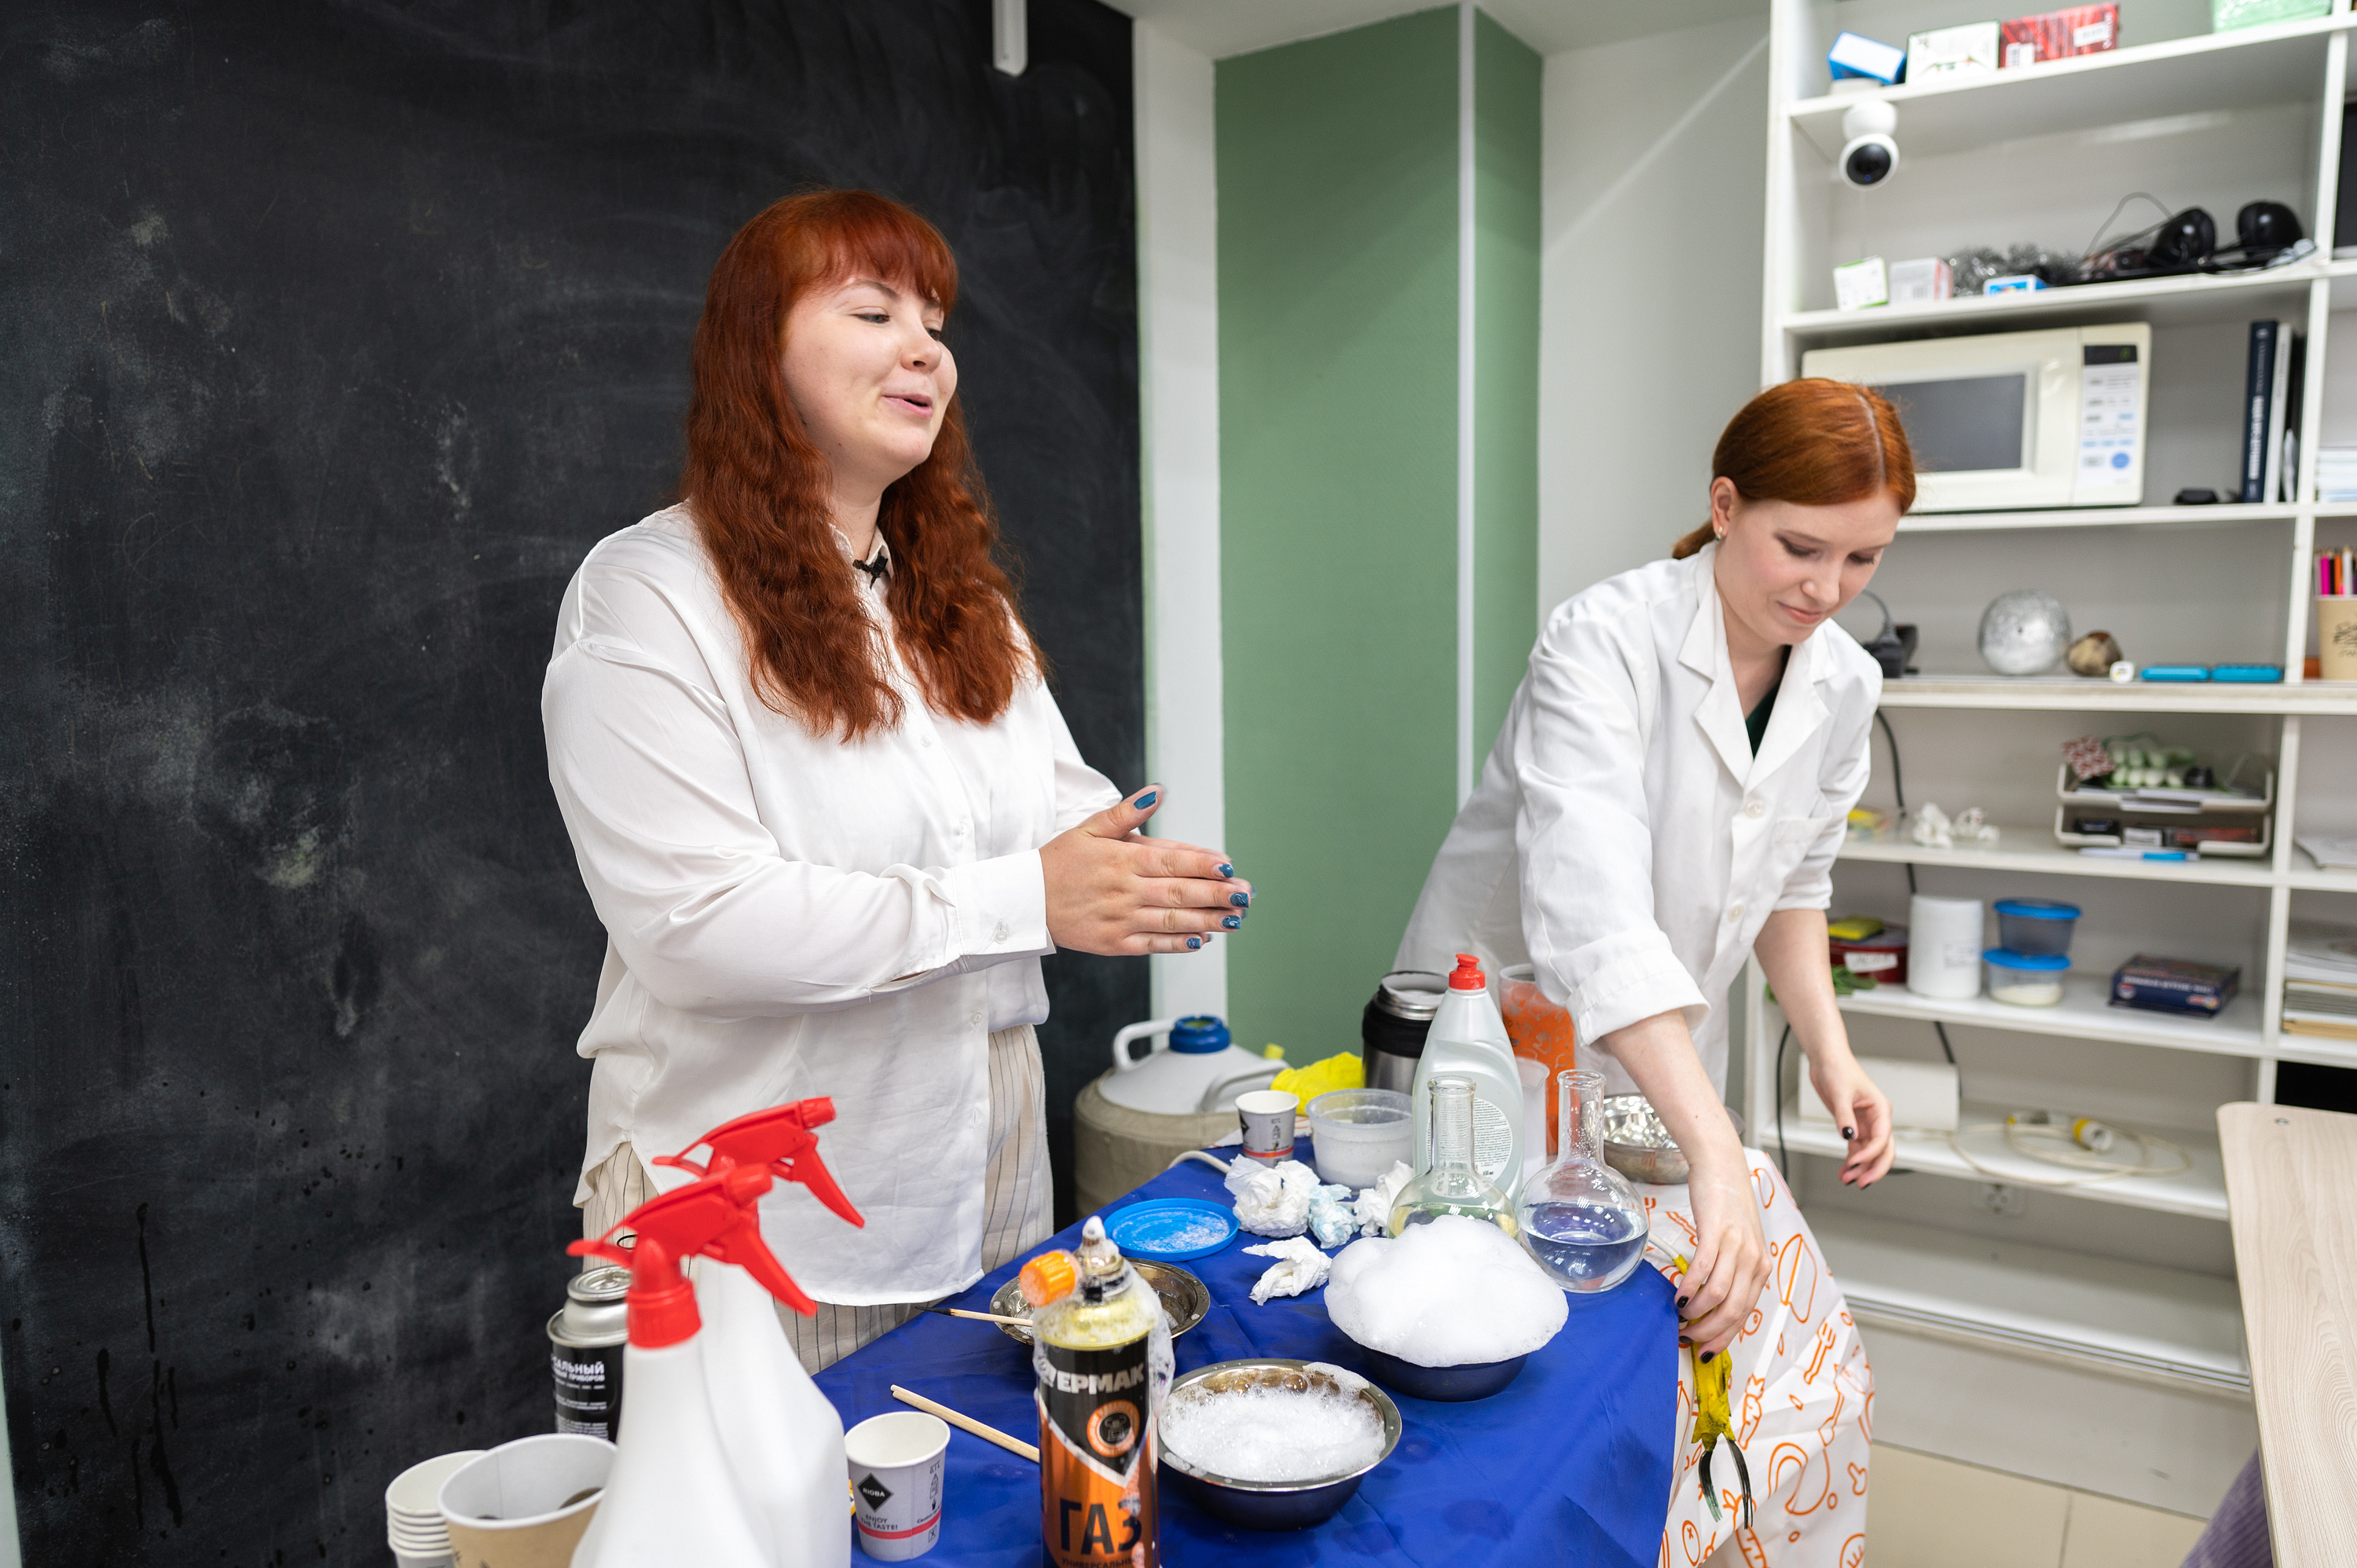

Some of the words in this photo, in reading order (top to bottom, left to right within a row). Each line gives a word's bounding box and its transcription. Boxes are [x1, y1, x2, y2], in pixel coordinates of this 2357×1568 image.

[551, 1355, 605, 1374] САЛЬНЫЙ
[863, 1487, 885, 1497] RIOBA
[861, 1517, 872, 1527] THE
[865, 1514, 888, 1523] ENJOY
[1060, 1497, 1142, 1555] ГАЗ
